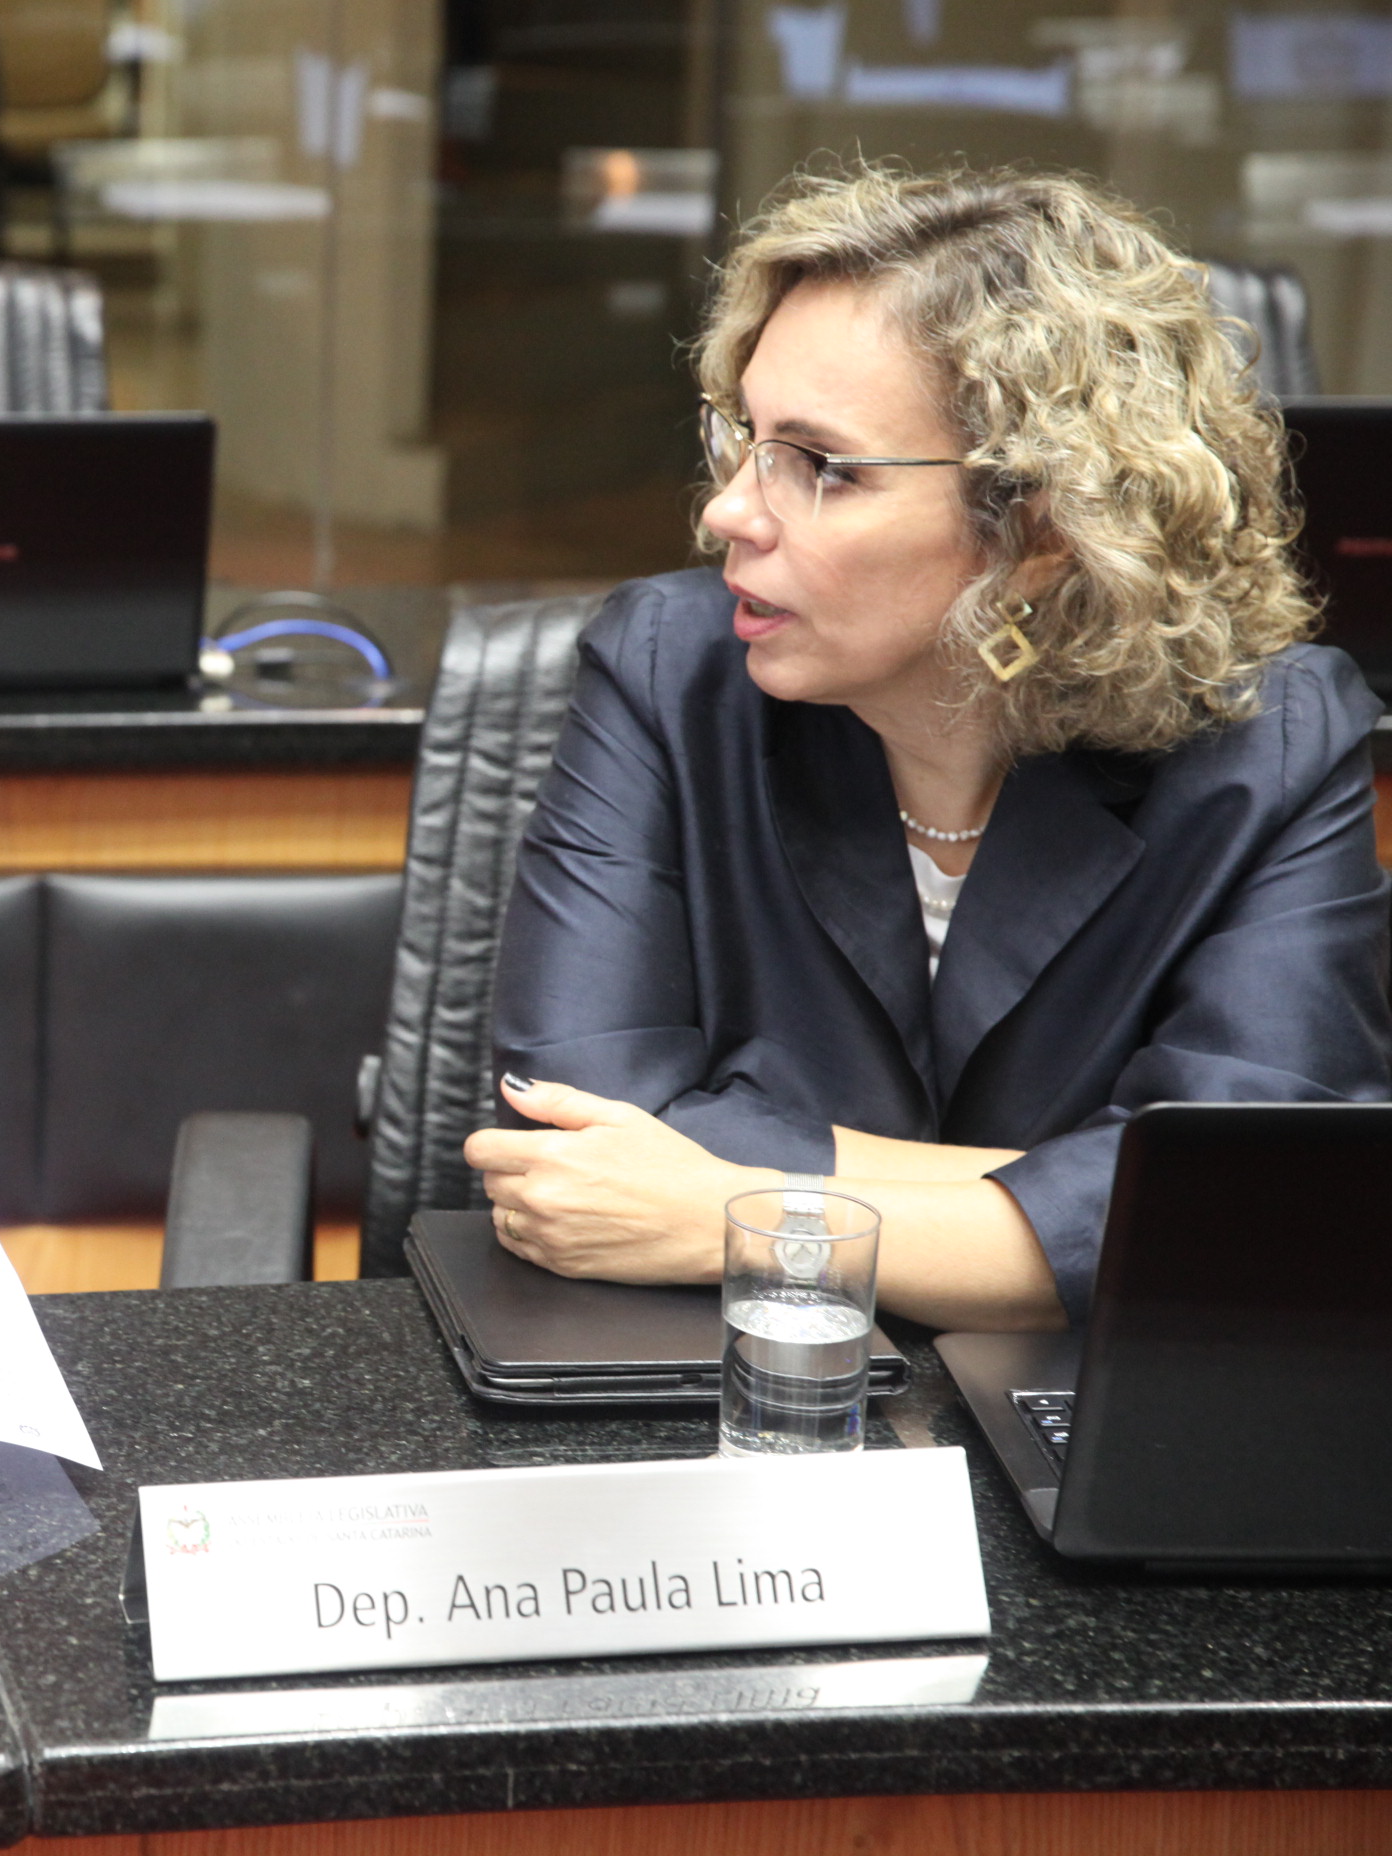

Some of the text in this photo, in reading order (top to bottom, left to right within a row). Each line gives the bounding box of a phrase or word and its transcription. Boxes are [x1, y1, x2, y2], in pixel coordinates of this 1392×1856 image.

[370, 1526, 433, 1541] CATARINA
[312, 1557, 826, 1640] Dep. Ana Paula Lima
